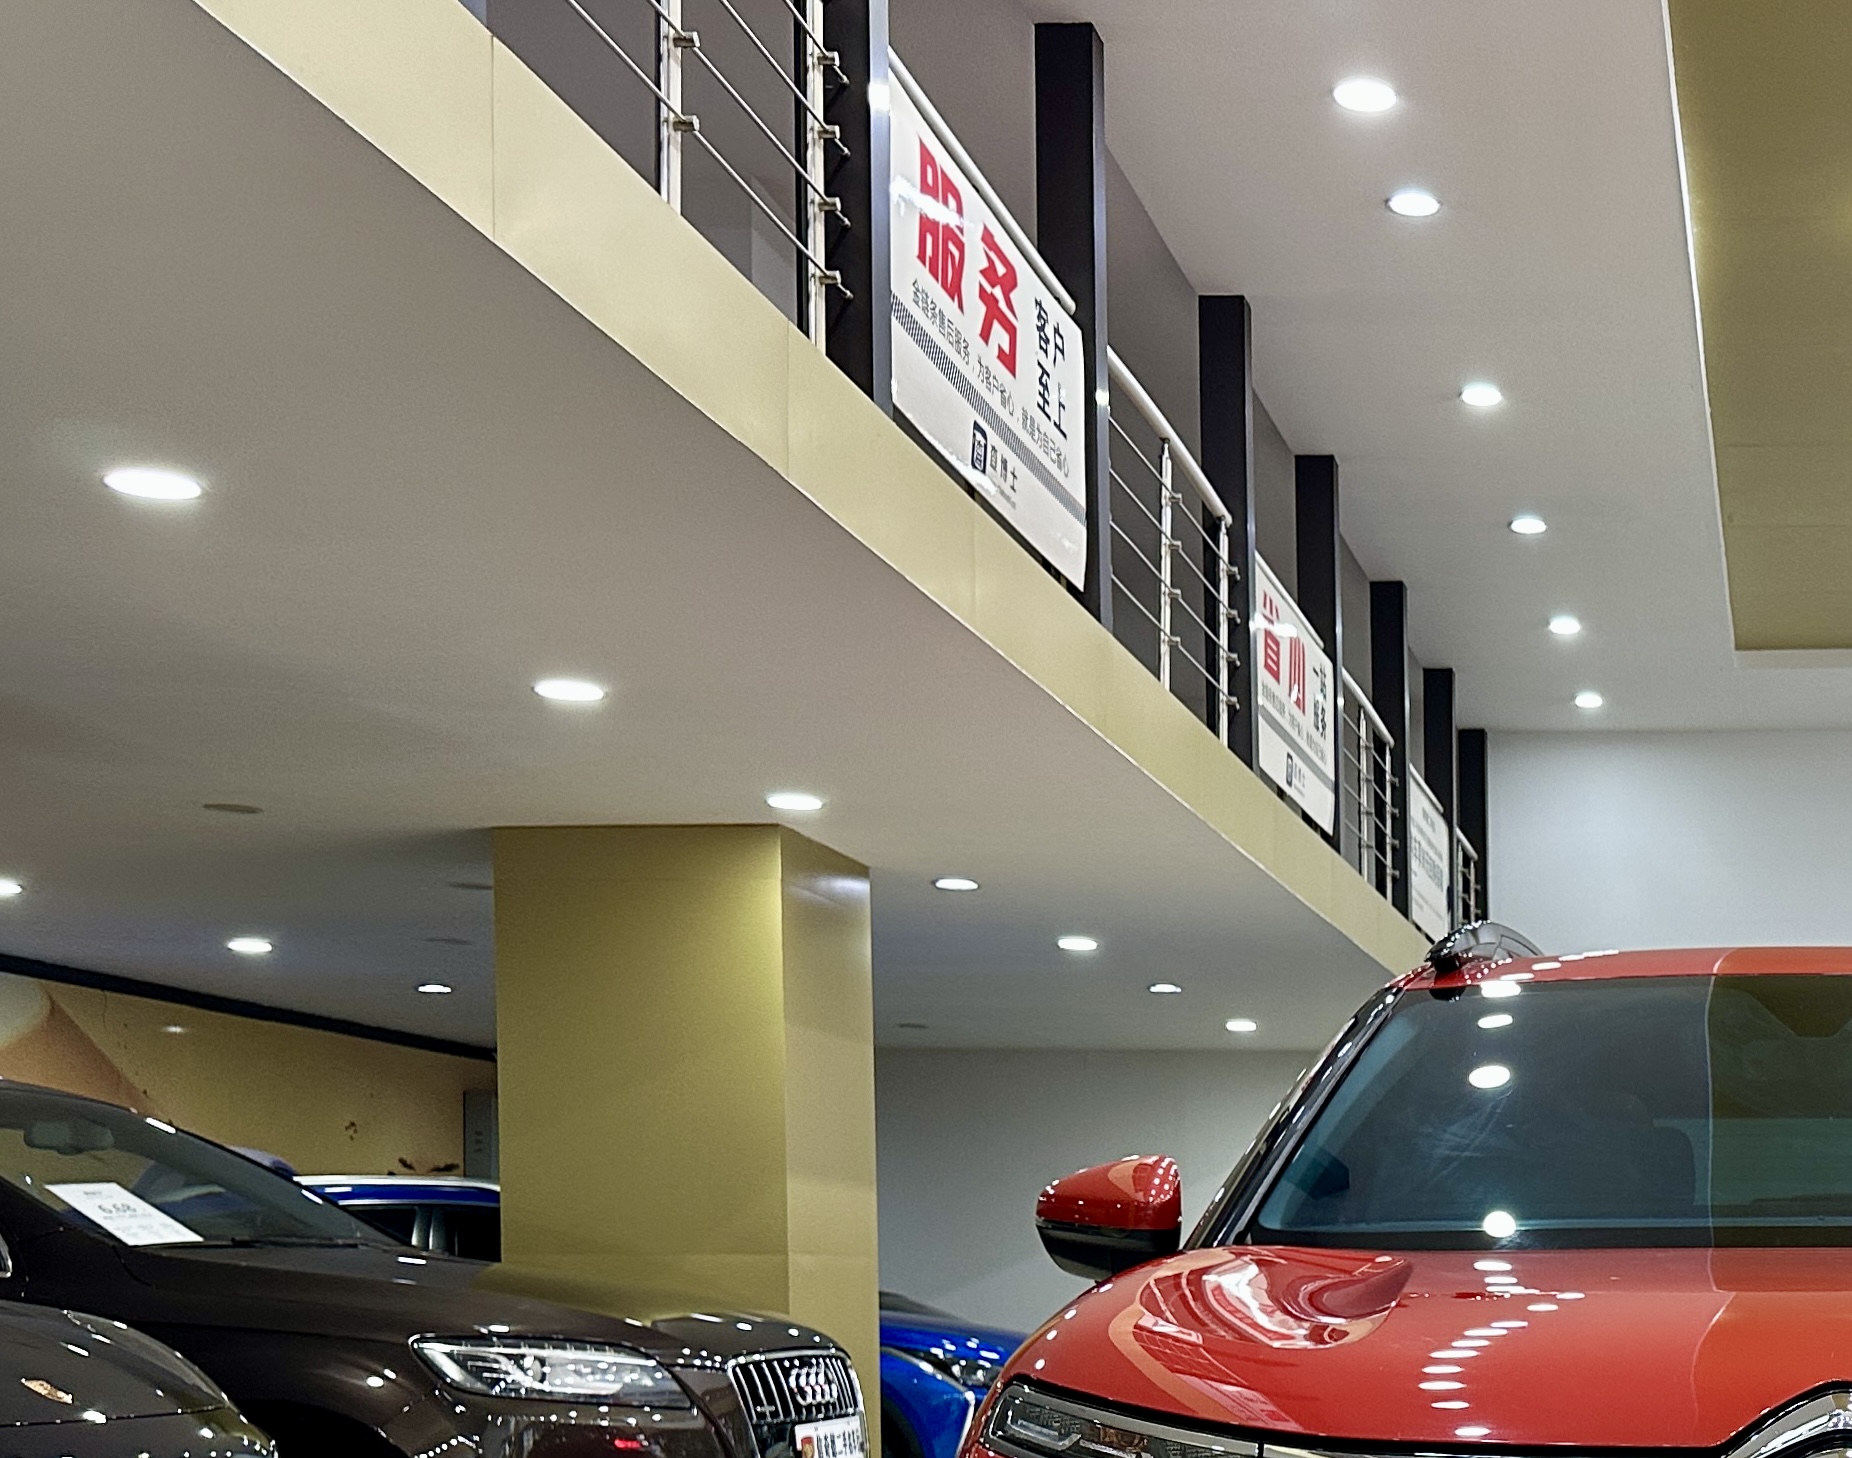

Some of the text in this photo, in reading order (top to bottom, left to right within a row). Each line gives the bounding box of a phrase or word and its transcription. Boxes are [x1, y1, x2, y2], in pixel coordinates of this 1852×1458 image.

[916, 134, 1018, 379] 服务
[1035, 296, 1065, 368] 客户
[1036, 359, 1067, 441] 至上
